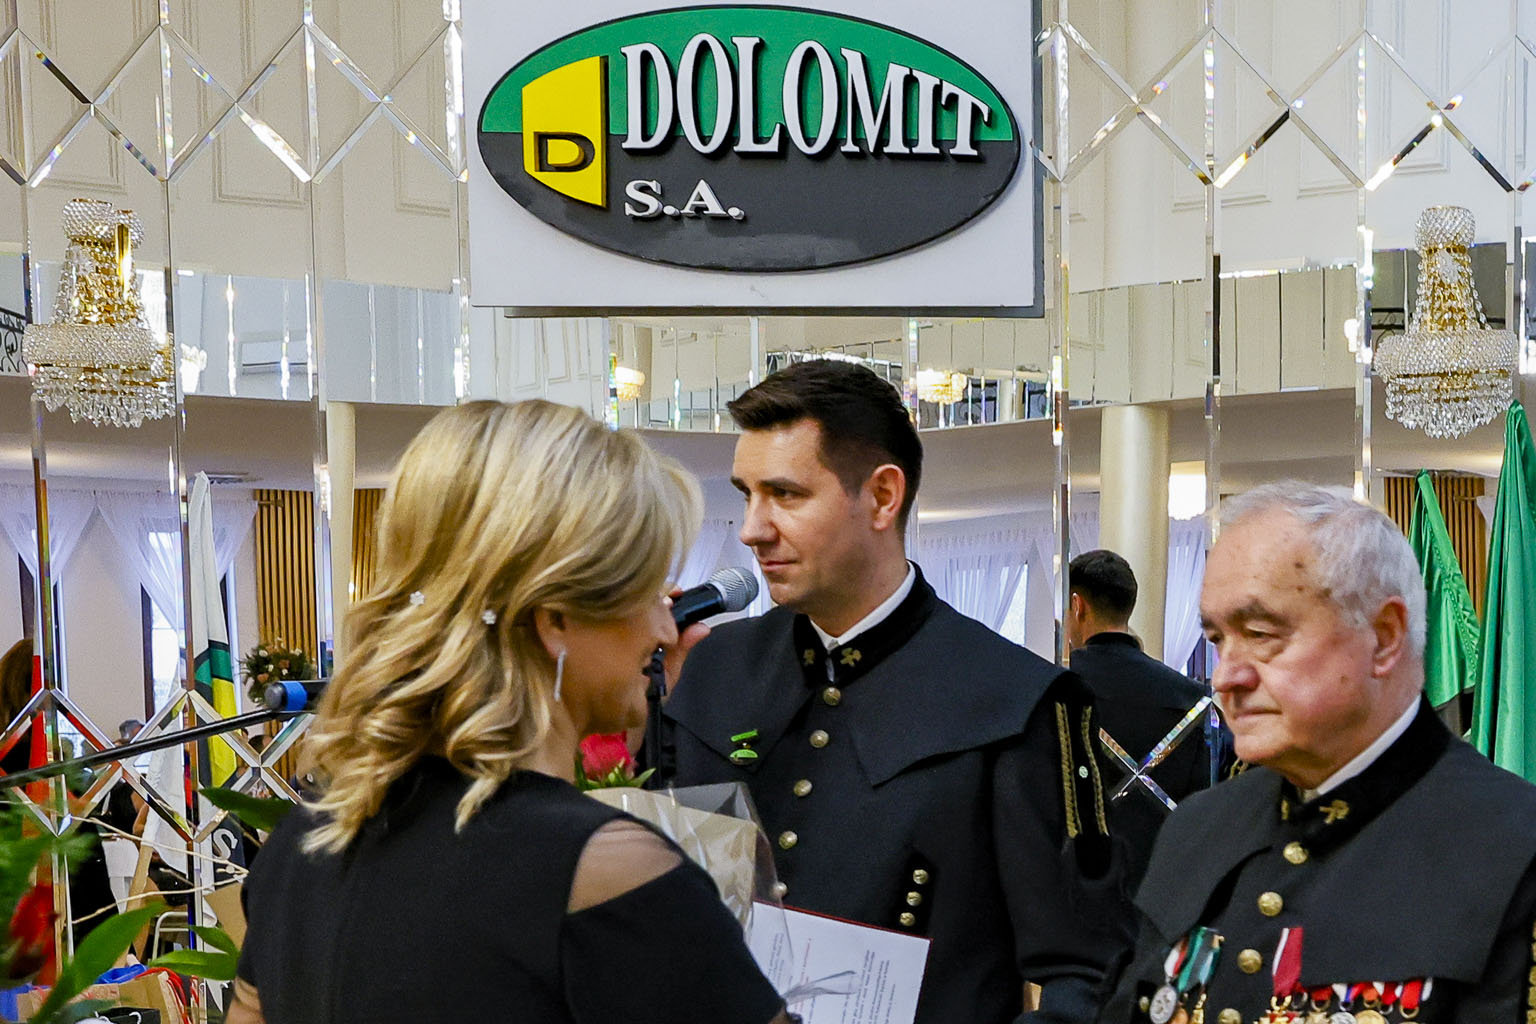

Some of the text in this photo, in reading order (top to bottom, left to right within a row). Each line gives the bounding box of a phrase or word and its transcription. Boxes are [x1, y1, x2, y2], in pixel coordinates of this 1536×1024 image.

[621, 33, 990, 157] DOLOMIT
[533, 130, 596, 174] D
[624, 178, 746, 221] S.A.
